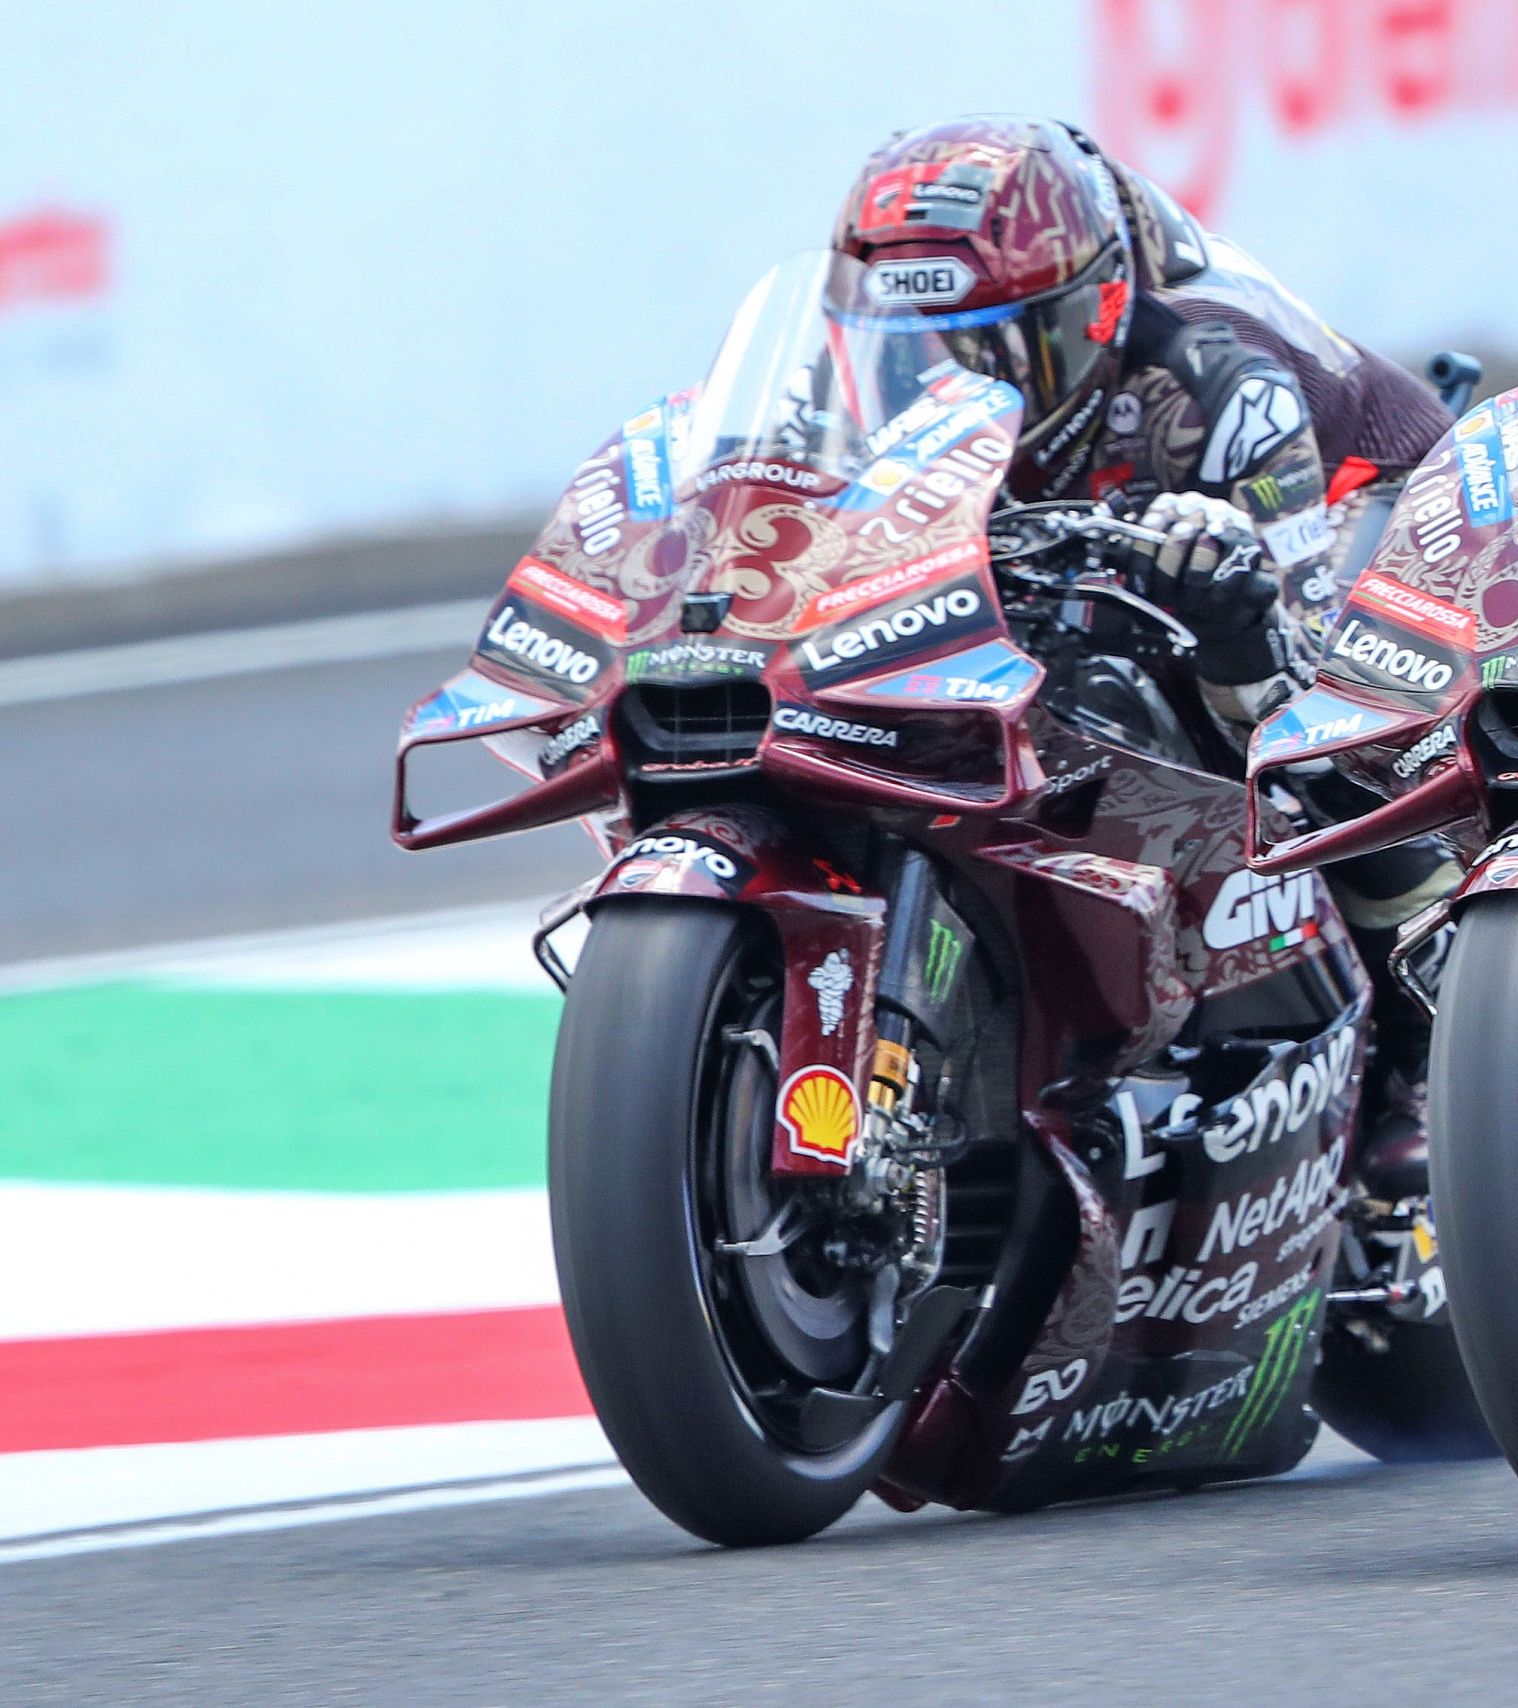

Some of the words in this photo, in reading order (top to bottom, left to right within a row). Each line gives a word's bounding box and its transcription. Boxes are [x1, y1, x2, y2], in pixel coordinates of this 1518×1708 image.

[879, 270, 956, 294] SHOEI
[1462, 443, 1500, 512] ADVANCE
[817, 542, 980, 613] FRECCIAROSSA
[1360, 578, 1472, 630] FRECCIAROSSA
[487, 606, 599, 683] Lenovo
[650, 643, 766, 668] MONSTER
[802, 589, 980, 671] Lenovo
[1333, 619, 1454, 690] Lenovo
[457, 699, 517, 728] TIM
[945, 676, 1011, 699] TIM
[774, 707, 898, 748] CARRERA
[1304, 713, 1364, 745] TIM
[1391, 725, 1458, 779] CARRERA
[622, 836, 738, 879] novo
[1202, 868, 1316, 950] GIVI
[1195, 1135, 1346, 1262] NetApp
[1114, 1262, 1259, 1324] elica
[1062, 1365, 1254, 1441] MONSTER
